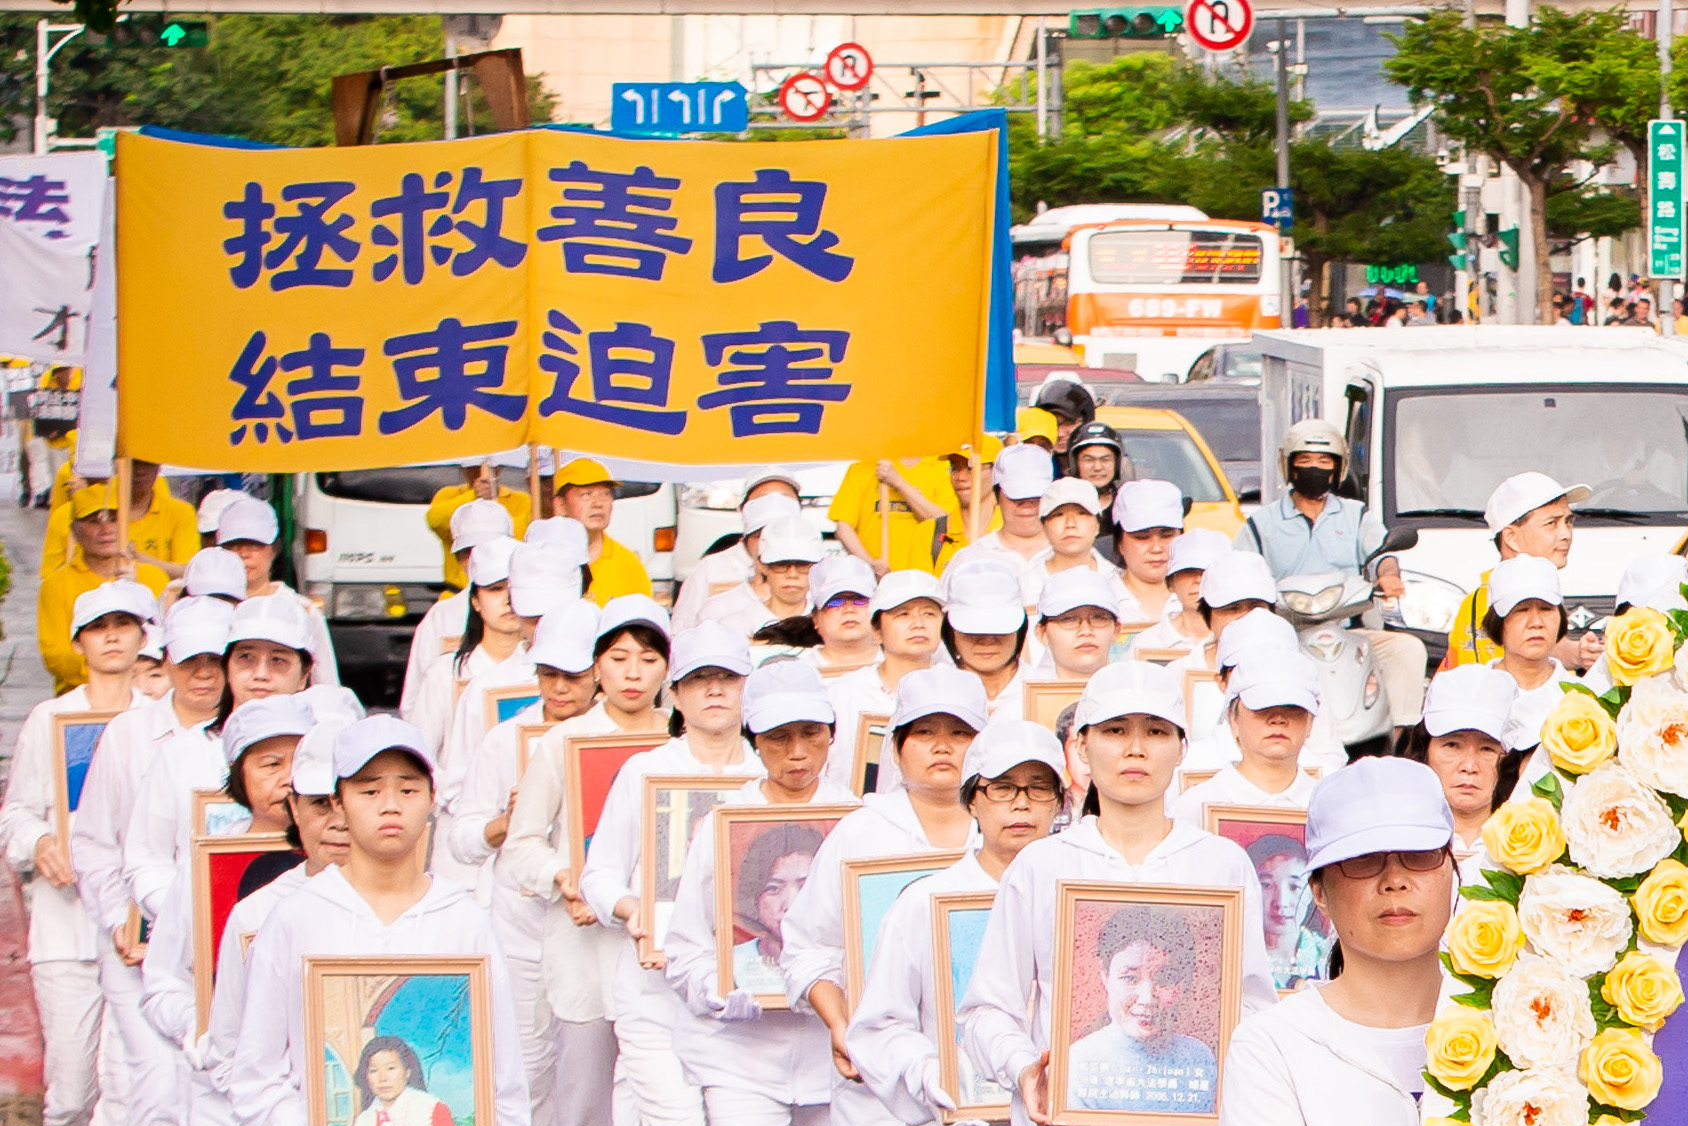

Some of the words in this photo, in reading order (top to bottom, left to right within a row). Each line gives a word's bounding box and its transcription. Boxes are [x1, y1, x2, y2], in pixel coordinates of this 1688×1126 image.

[223, 161, 854, 292] 拯救善良
[229, 308, 850, 446] 結束迫害
